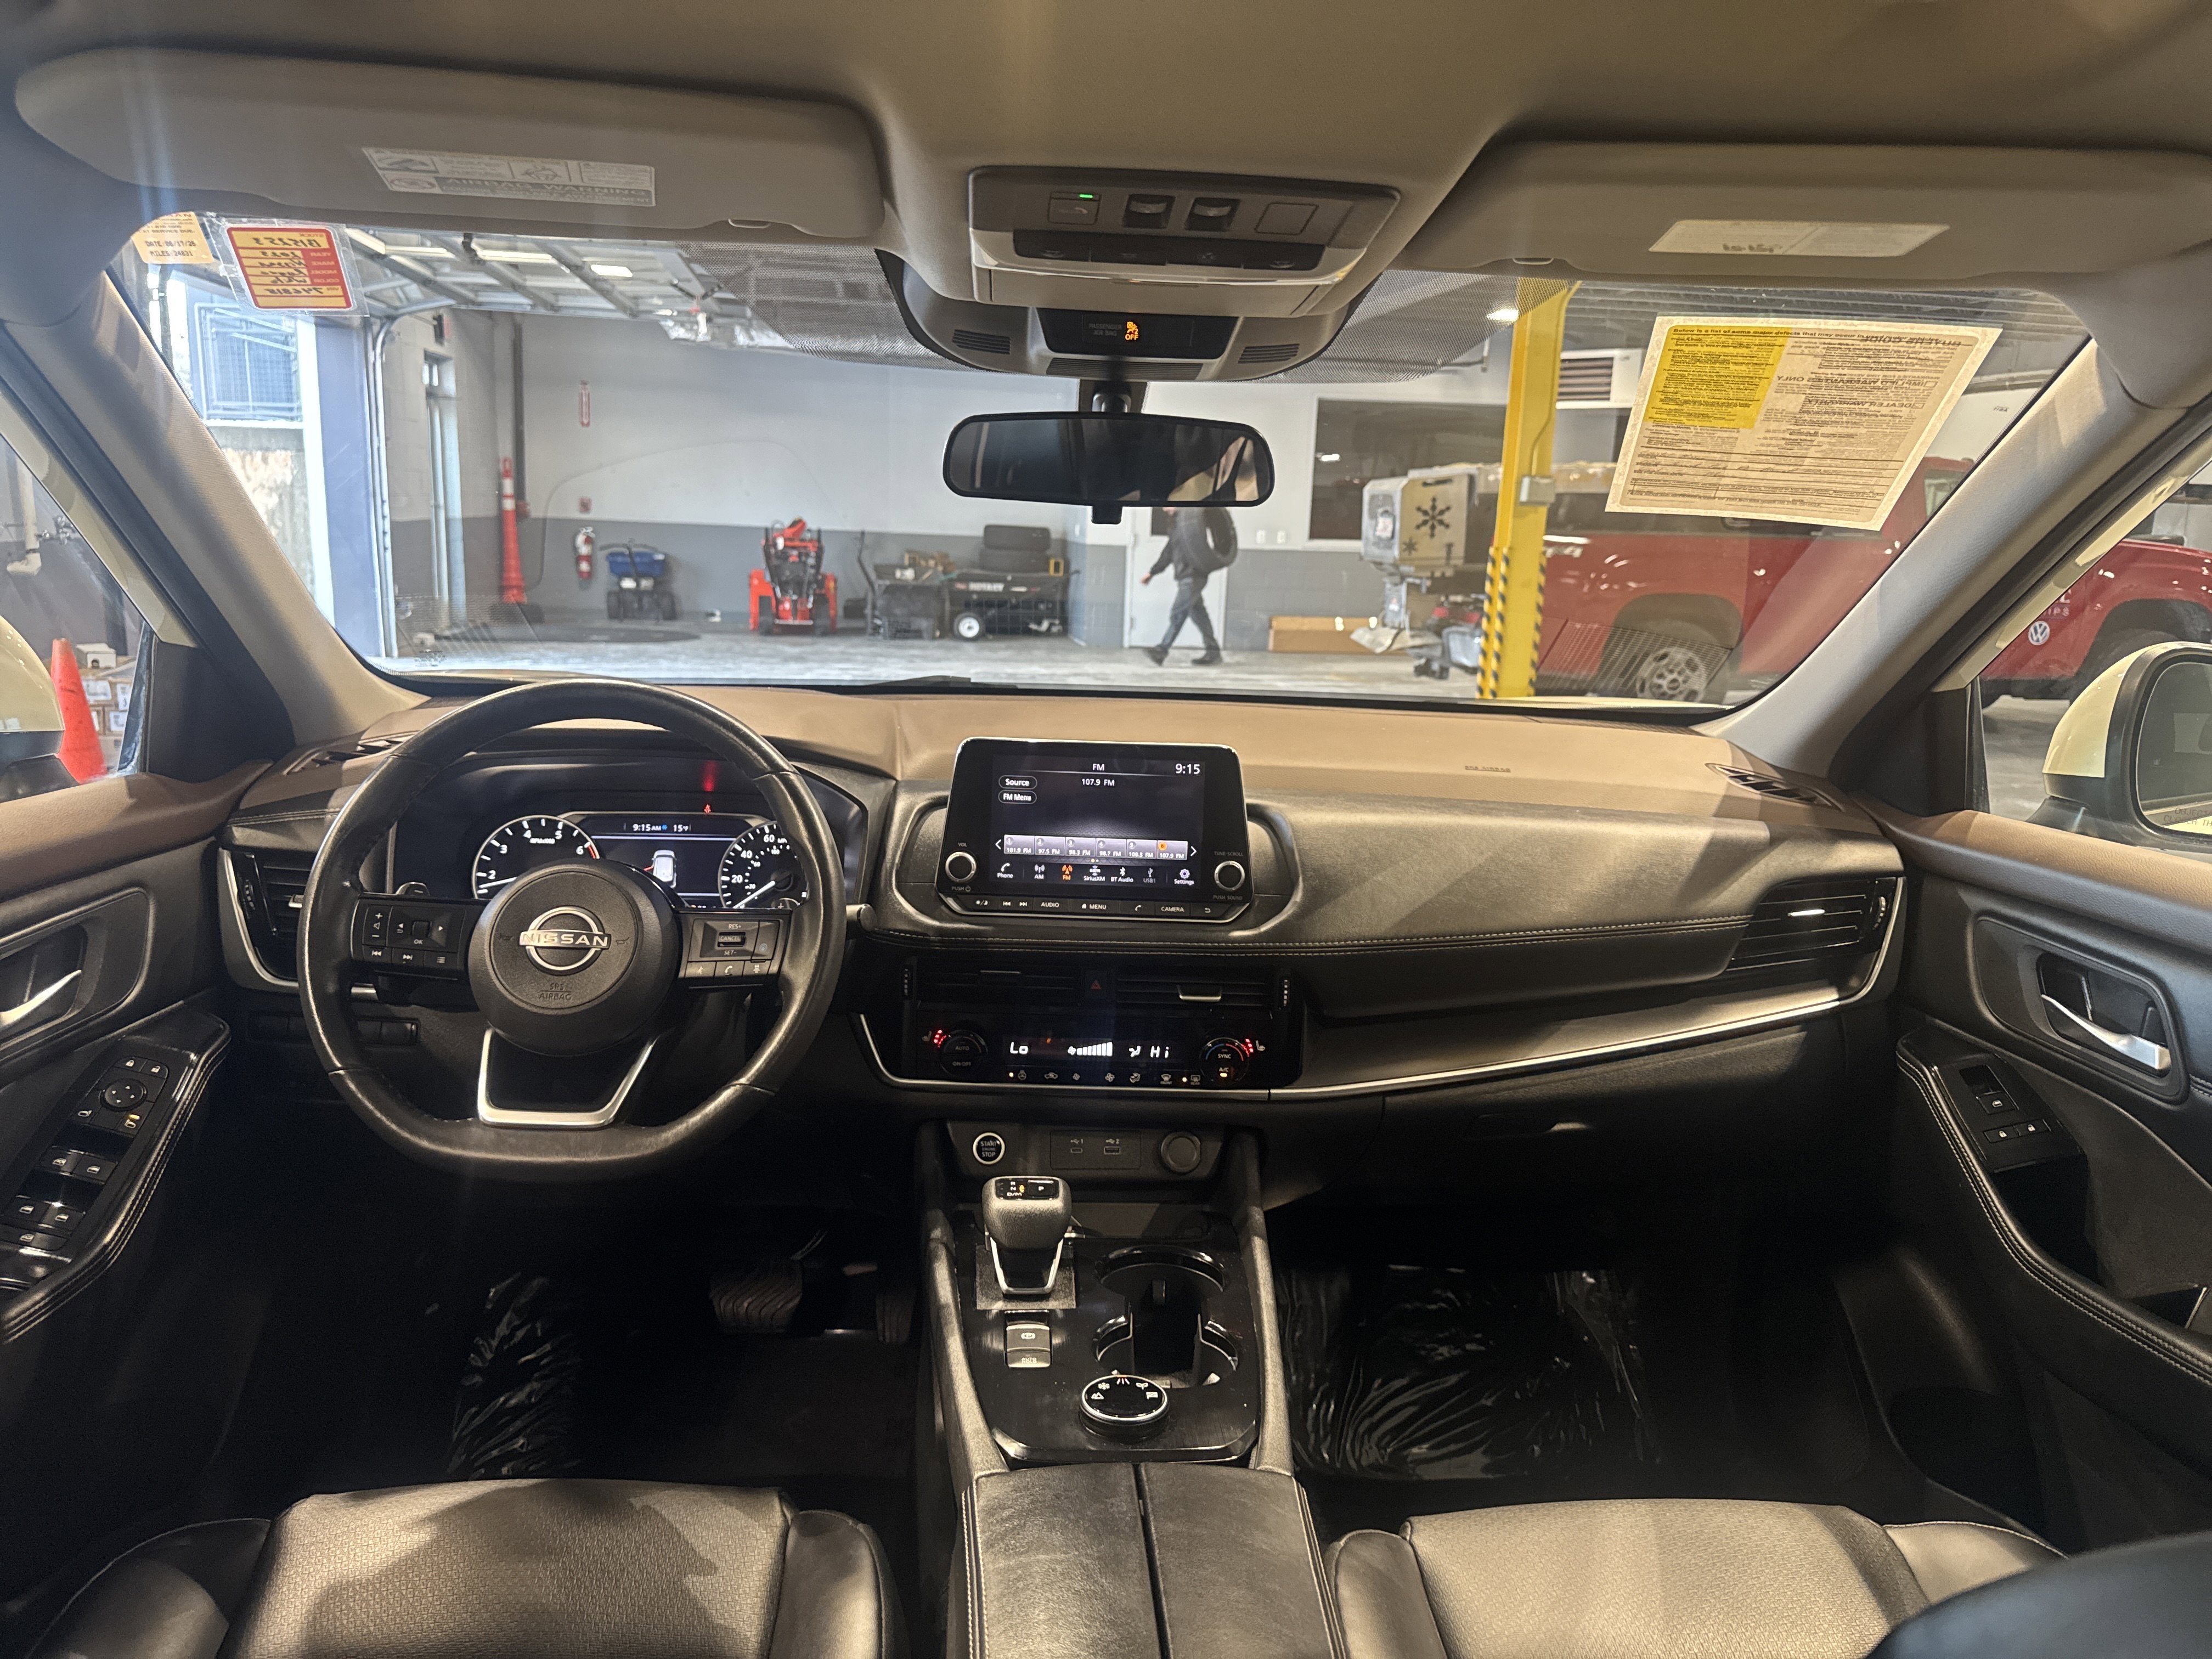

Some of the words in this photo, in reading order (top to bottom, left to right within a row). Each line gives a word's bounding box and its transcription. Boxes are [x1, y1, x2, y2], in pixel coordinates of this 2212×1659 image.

[1175, 763, 1200, 775] 9:15
[523, 830, 532, 838] 4
[555, 830, 562, 839] 5
[763, 834, 775, 843] 60
[499, 844, 507, 854] 3
[575, 845, 584, 855] 6
[741, 850, 752, 859] 40
[488, 870, 496, 879] 2
[731, 874, 743, 883] 20
[522, 933, 608, 947] NISSAN
[538, 992, 572, 1001] AIRBAG
[1009, 1041, 1029, 1054] Lo
[1150, 1046, 1169, 1058] Hi
